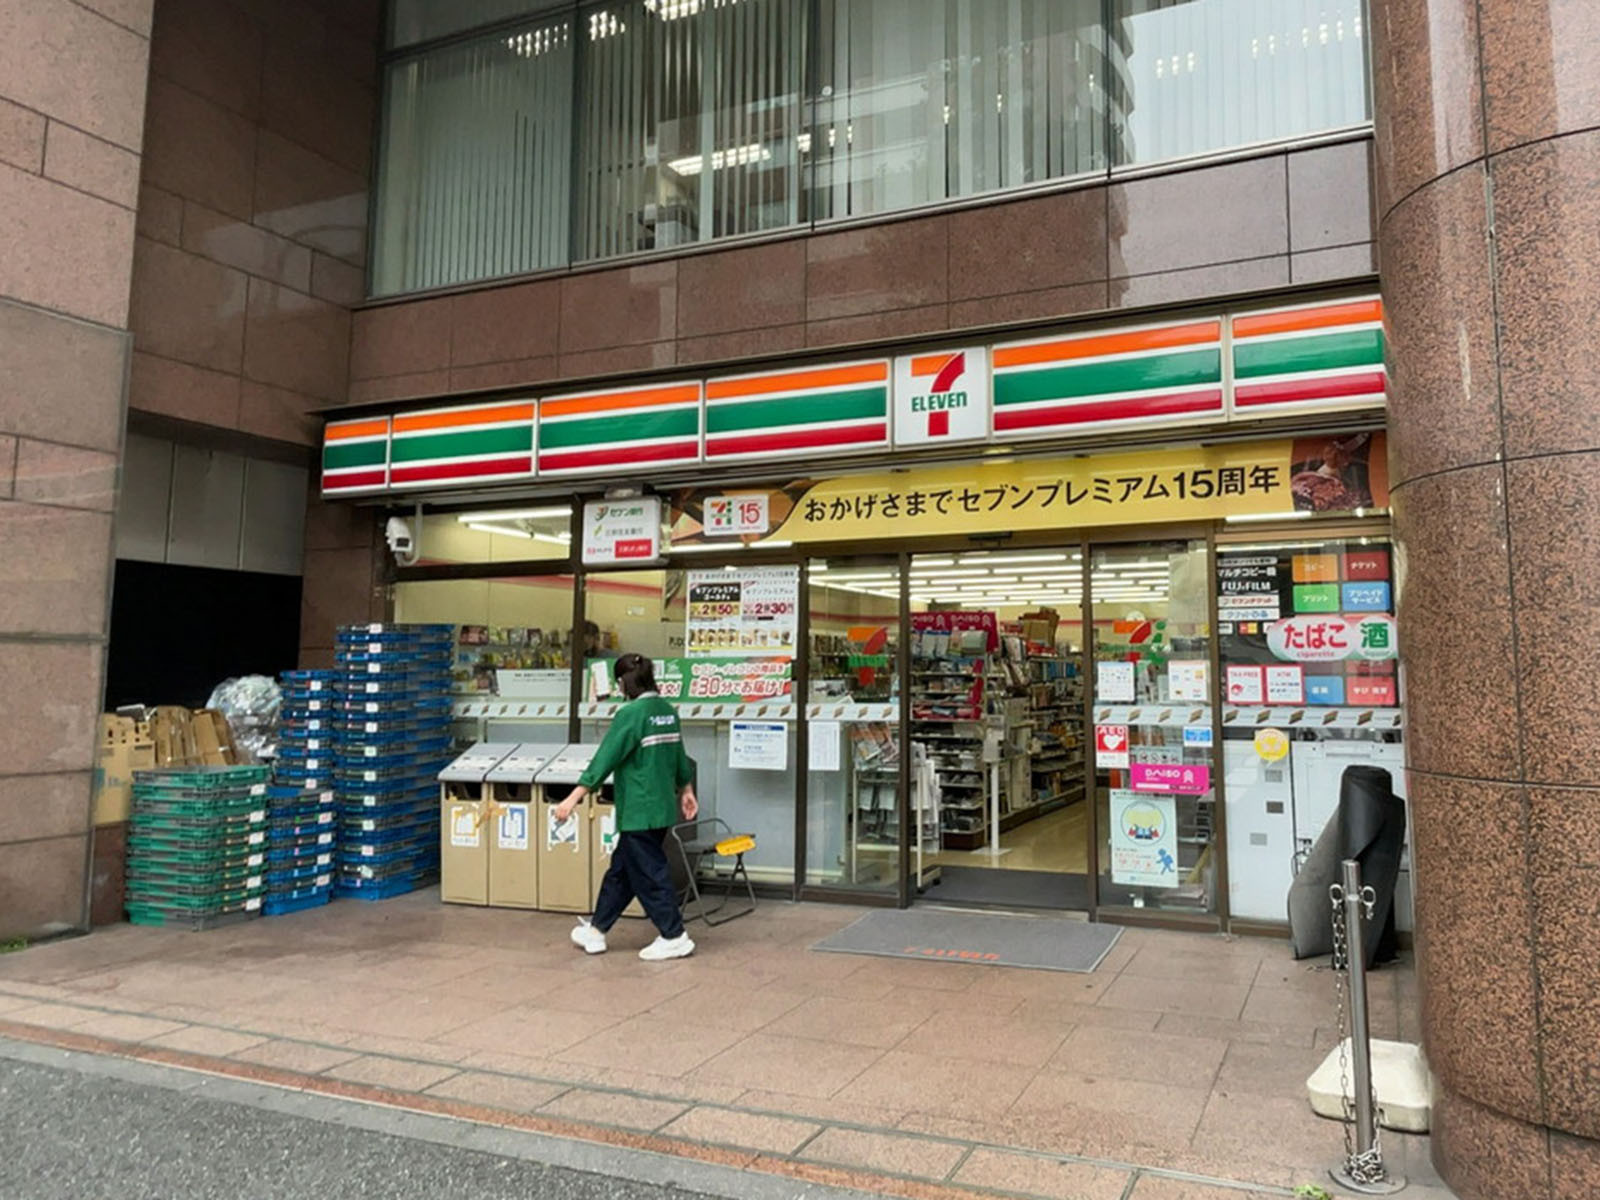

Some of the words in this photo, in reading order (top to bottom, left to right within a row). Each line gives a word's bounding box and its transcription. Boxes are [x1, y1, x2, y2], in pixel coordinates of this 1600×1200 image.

[804, 465, 1280, 522] おかげさまでセブンプレミアム15周年
[1284, 622, 1347, 649] たばこ
[1361, 622, 1389, 648] 酒
